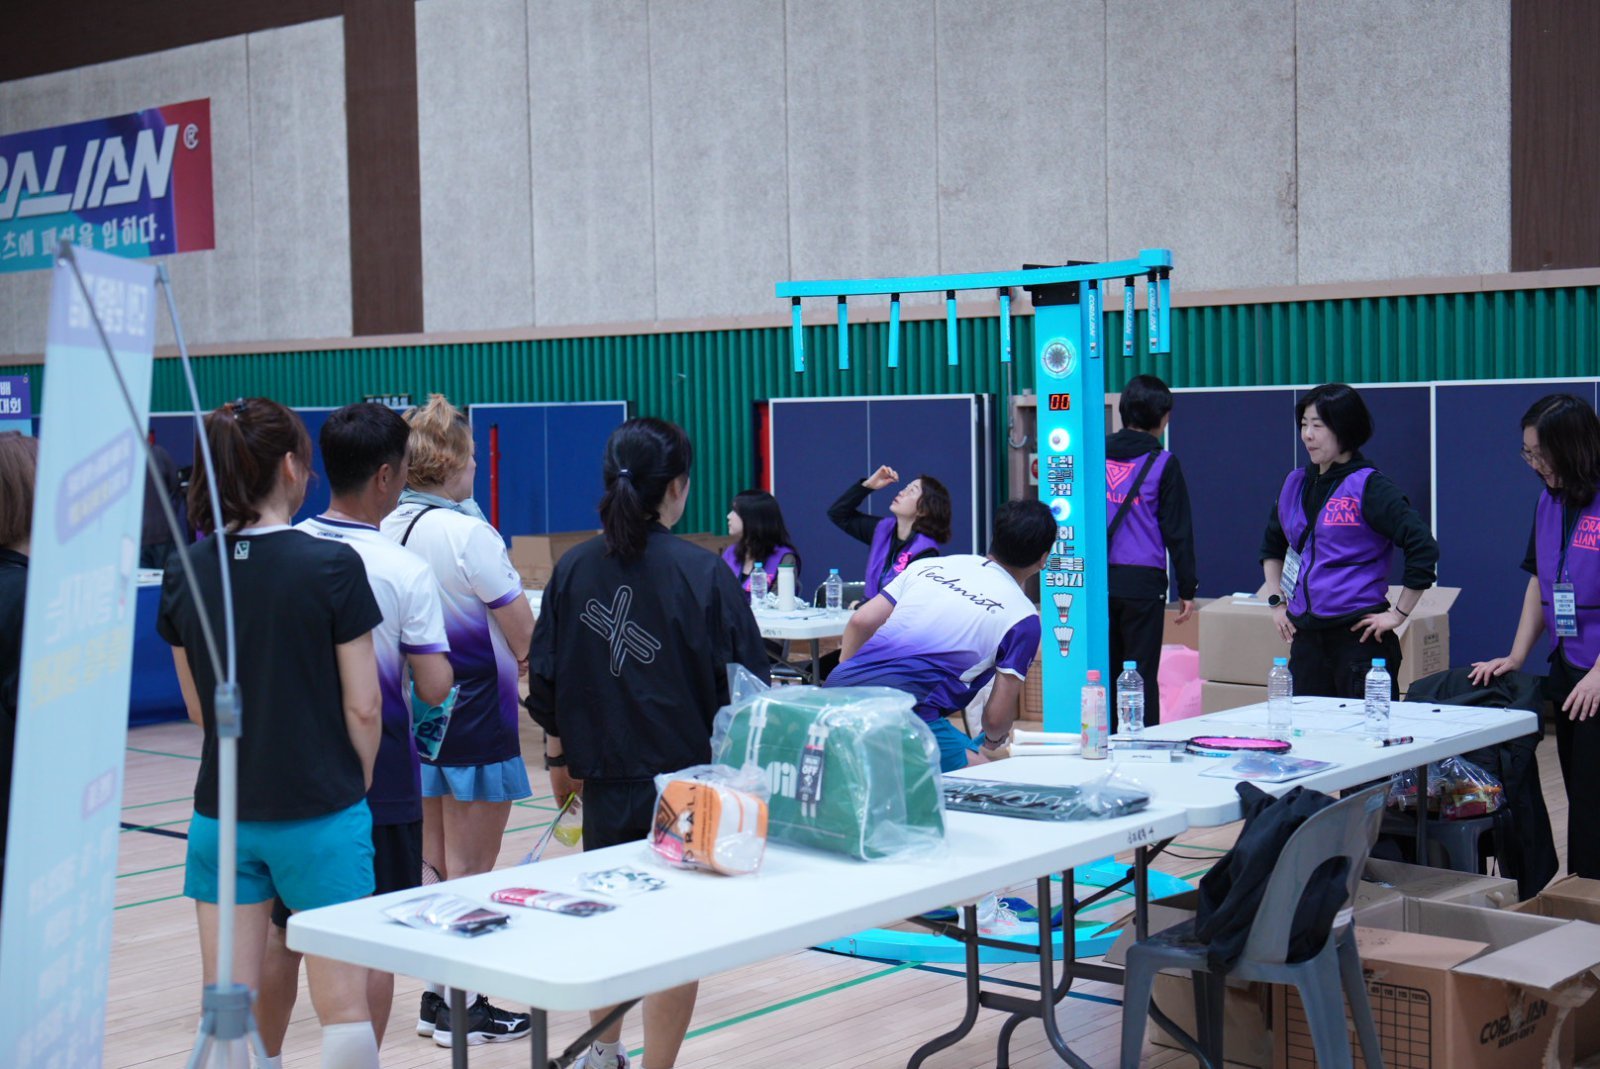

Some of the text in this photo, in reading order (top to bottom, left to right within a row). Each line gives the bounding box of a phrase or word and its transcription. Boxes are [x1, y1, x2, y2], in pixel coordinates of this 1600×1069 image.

[102, 213, 166, 250] 입히다.
[1050, 394, 1070, 410] 00
[917, 565, 1005, 612] Technist
[1480, 999, 1549, 1045] CORIAN
